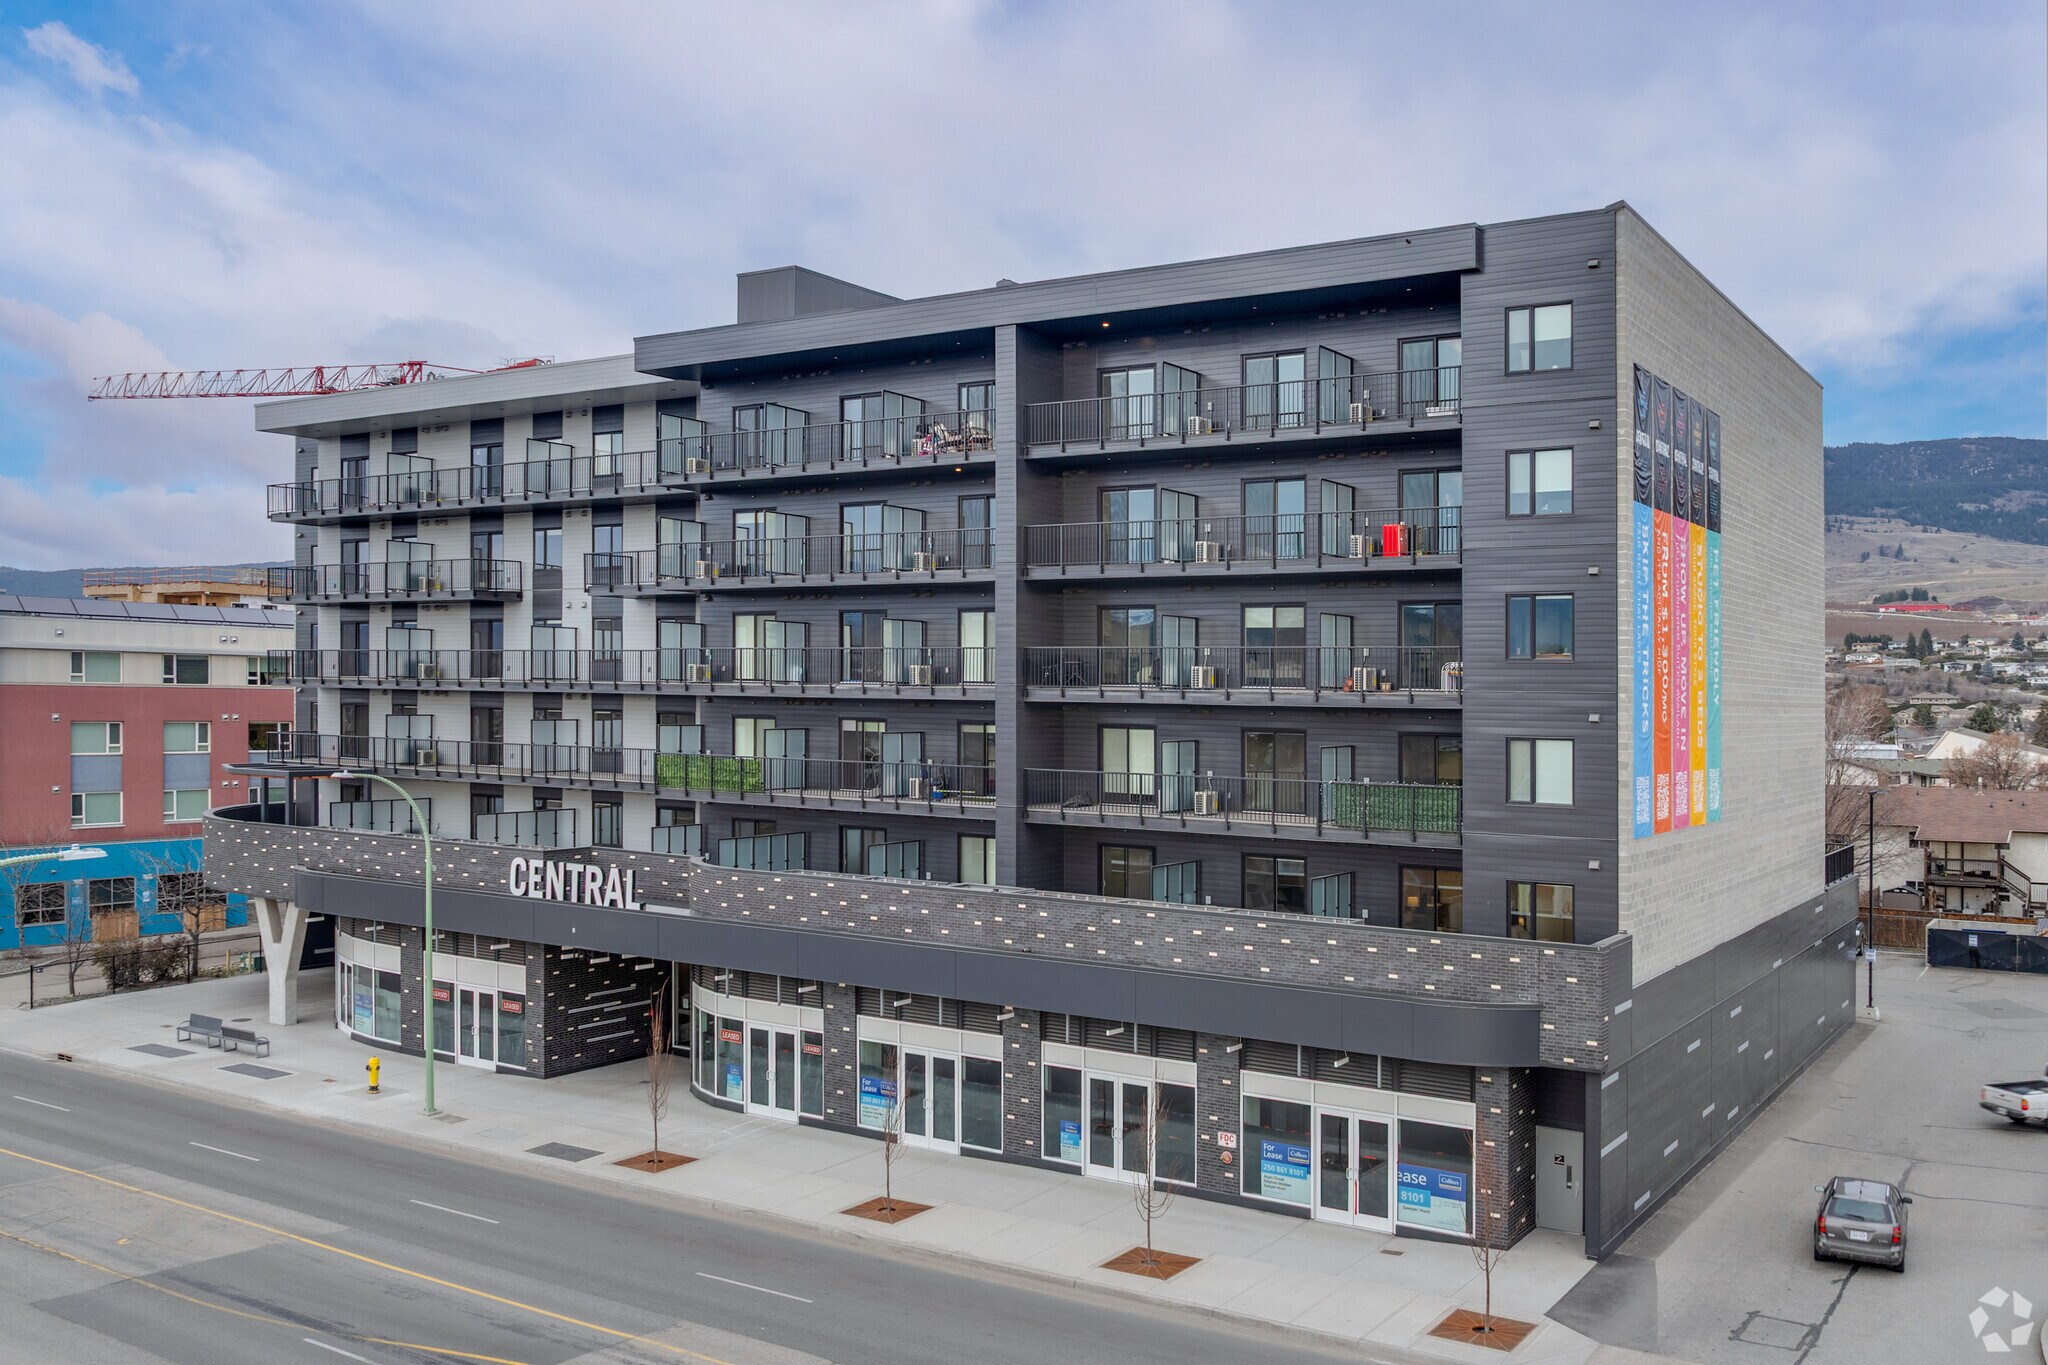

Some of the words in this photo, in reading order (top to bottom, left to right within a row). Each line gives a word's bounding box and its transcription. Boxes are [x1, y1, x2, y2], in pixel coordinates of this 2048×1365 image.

[1697, 635, 1703, 661] TO
[1661, 607, 1669, 723] $1,300/MO
[1697, 669, 1703, 681] 3
[1680, 728, 1686, 750] IN
[509, 856, 642, 911] CENTRAL
[503, 1002, 520, 1010] LEASED
[722, 1031, 740, 1041] LEASED
[805, 1045, 820, 1053] LEASED
[862, 1085, 878, 1093] Lease
[1219, 1133, 1235, 1143] FDC
[1263, 1143, 1275, 1151] For
[1263, 1151, 1283, 1160] Lease
[1290, 1150, 1308, 1159] Colliers
[1263, 1164, 1275, 1172] 250
[1276, 1166, 1288, 1174] 861
[1289, 1168, 1304, 1177] 8101
[1441, 1177, 1460, 1186] Colliers
[1401, 1191, 1424, 1203] 8101
